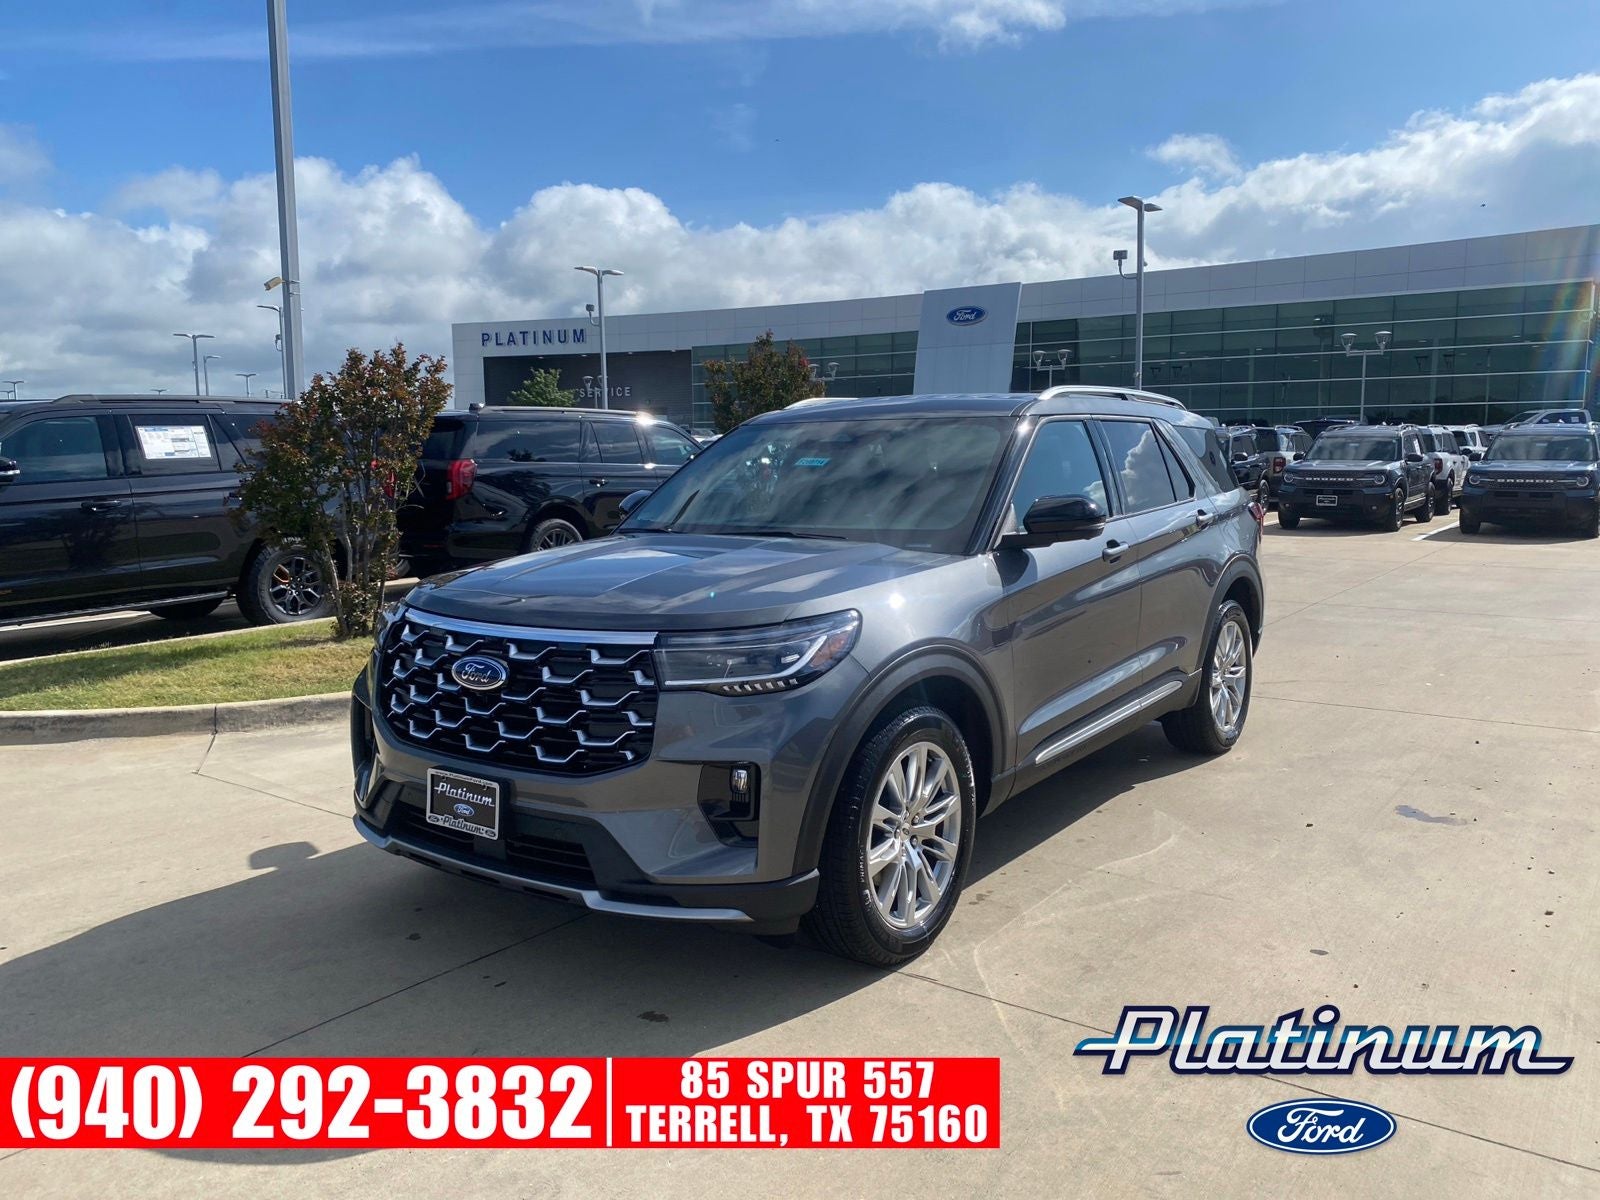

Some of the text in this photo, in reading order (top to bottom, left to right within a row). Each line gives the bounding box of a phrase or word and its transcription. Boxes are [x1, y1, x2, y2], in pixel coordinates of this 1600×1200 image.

[481, 328, 587, 346] PLATINUM
[579, 386, 631, 398] SERICE
[461, 662, 492, 683] Ford
[434, 782, 495, 807] Platinum
[443, 815, 484, 834] Platinum
